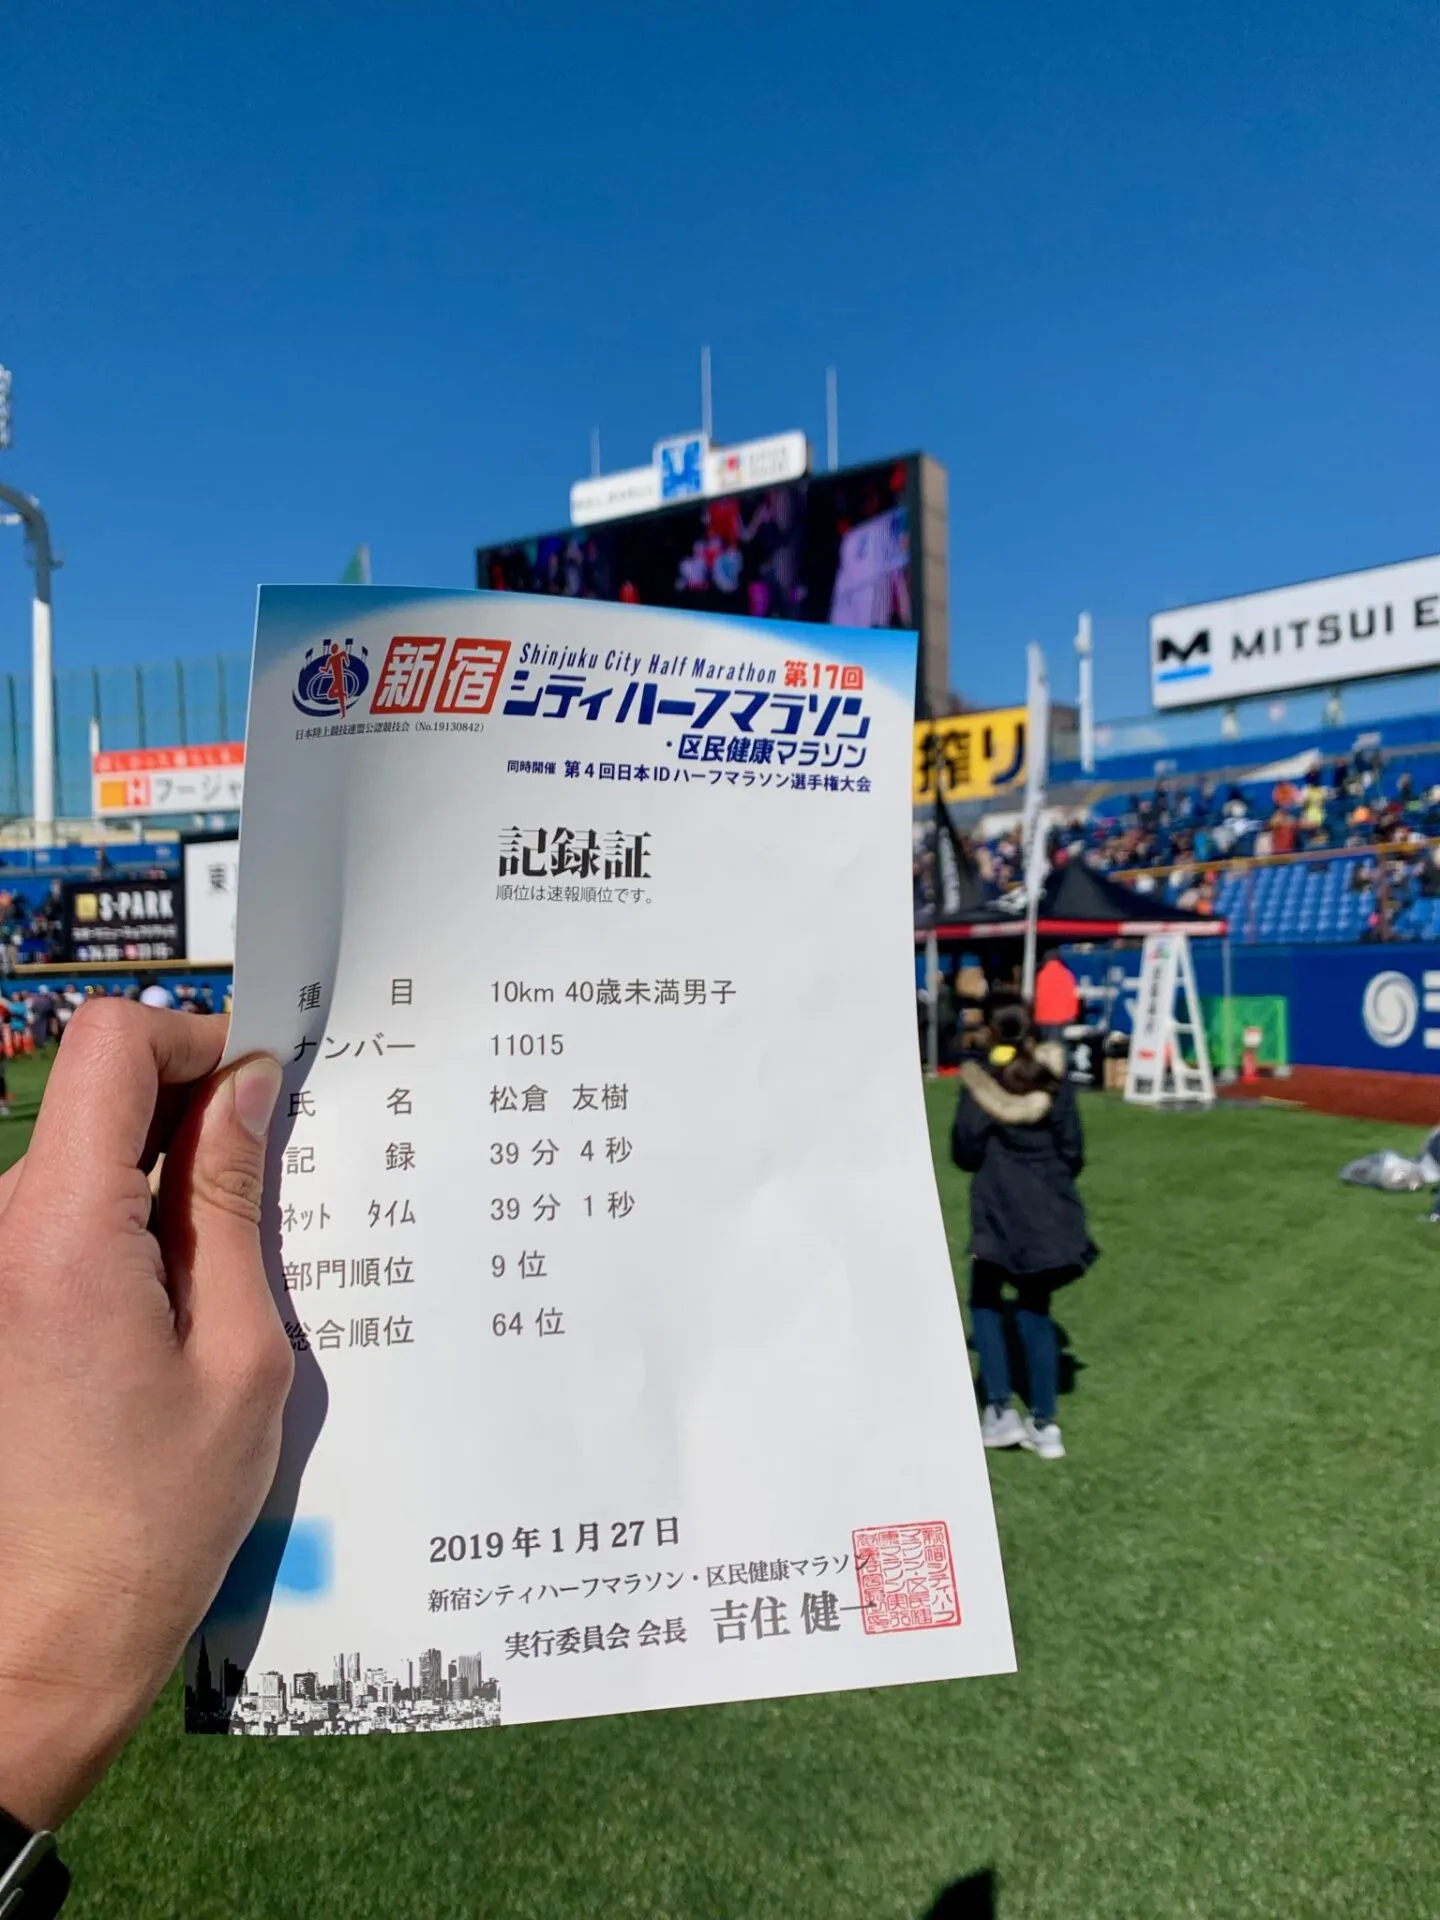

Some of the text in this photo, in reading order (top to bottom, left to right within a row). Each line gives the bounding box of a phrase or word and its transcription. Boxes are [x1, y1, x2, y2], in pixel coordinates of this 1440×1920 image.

[1231, 602, 1394, 661] MITSUI
[1414, 595, 1440, 628] E
[519, 642, 777, 684] Shinjuku City Half Marathon
[784, 659, 864, 691] 第17回
[373, 639, 871, 739] 新宿 シティハーフマラソン
[507, 759, 872, 793] 同時開催 第4回日本IDハーフマラソン選手権大会
[498, 825, 652, 880] 記録証
[495, 883, 652, 905] 順位は速報順位です。
[490, 978, 737, 1005] 10km 40歳未満男子
[294, 1032, 415, 1061] ナンバー
[490, 1034, 564, 1056] 11015
[489, 1083, 629, 1113] 松倉 友樹
[282, 1256, 415, 1292] 部門順位
[284, 1314, 415, 1351] 総合順位
[428, 1551, 872, 1613] 新宿シティハーフマラソン・区民健康マラソン
[504, 1616, 688, 1661] 実行委員会 会長
